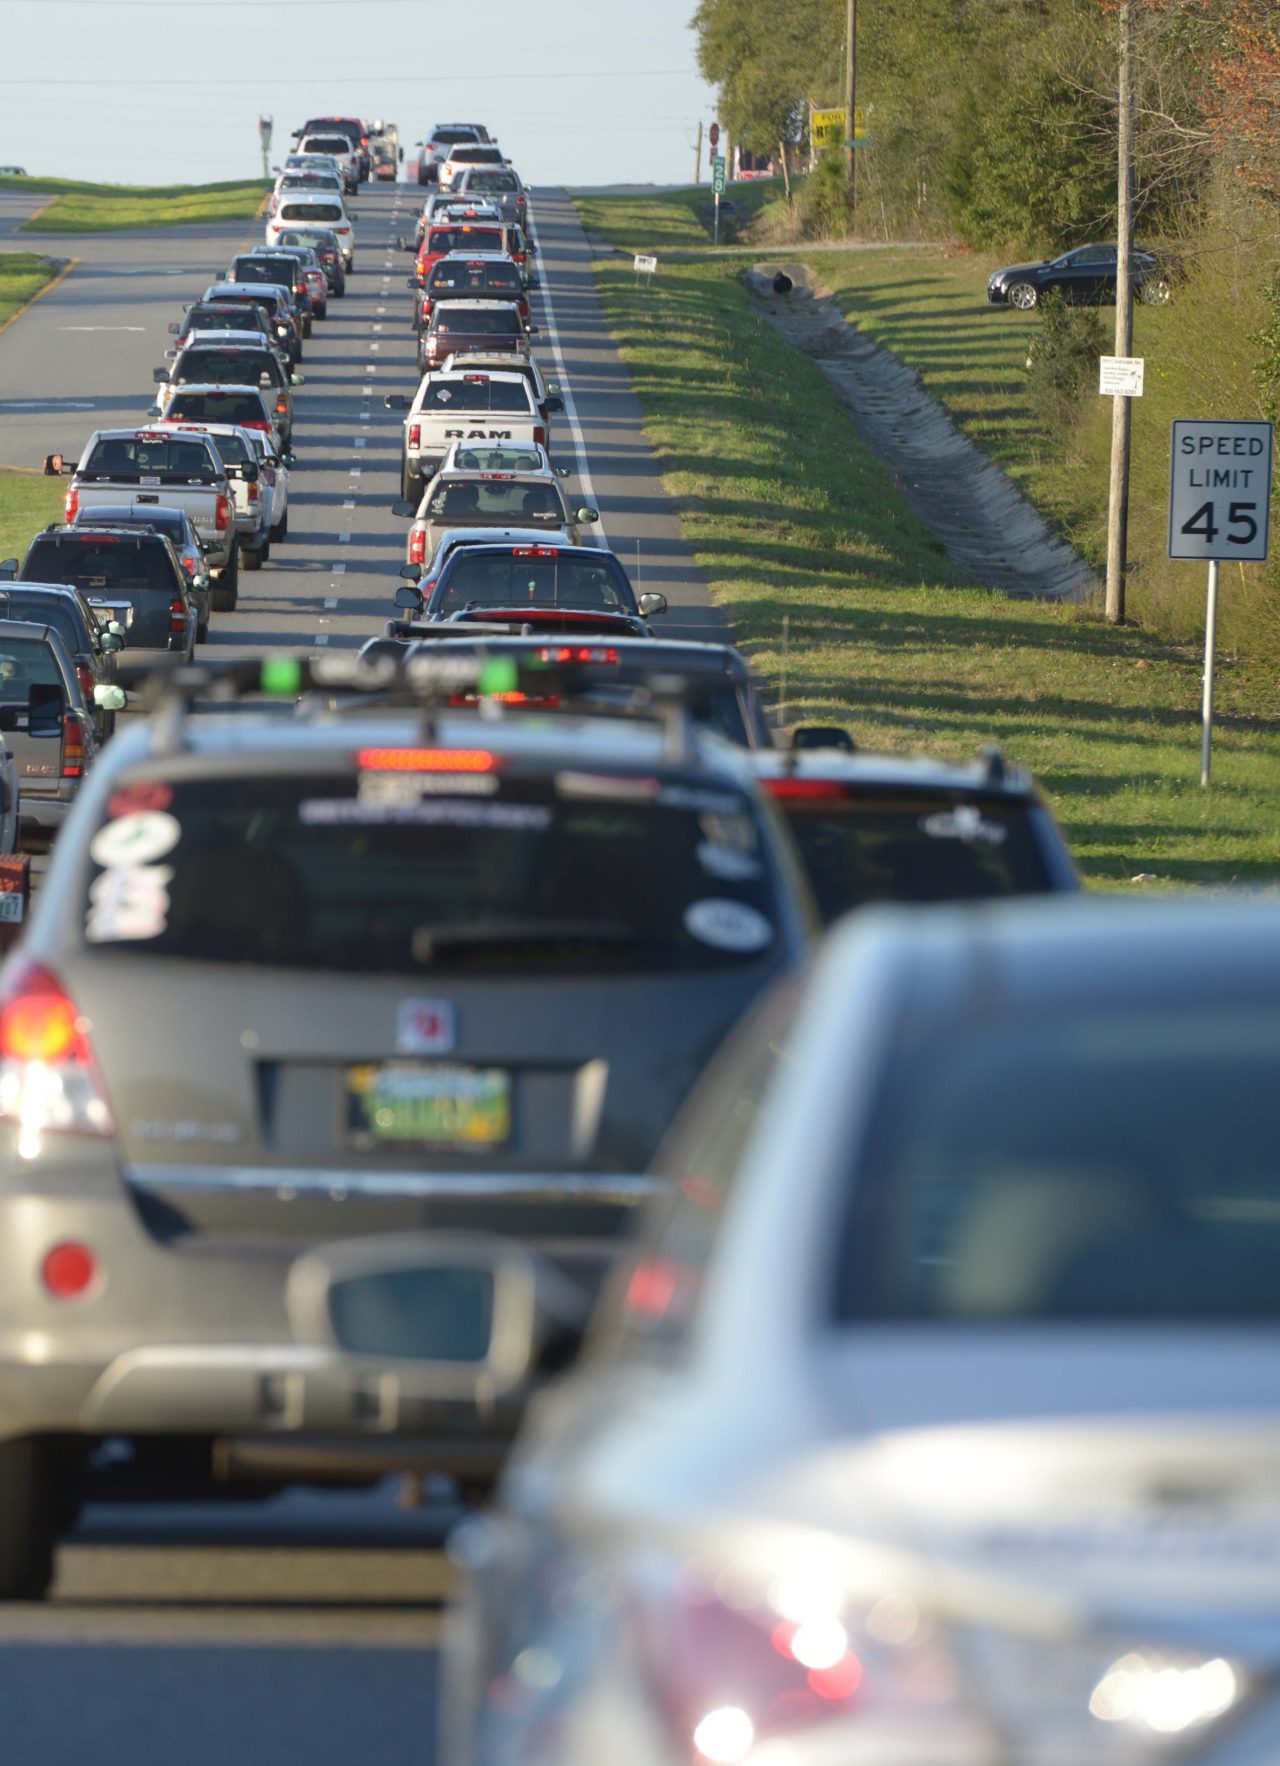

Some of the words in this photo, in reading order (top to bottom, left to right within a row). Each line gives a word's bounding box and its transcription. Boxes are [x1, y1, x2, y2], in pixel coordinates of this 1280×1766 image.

[445, 430, 511, 439] RAM
[1181, 436, 1264, 456] SPEED
[1189, 468, 1254, 488] LIMIT
[1181, 502, 1258, 545] 45
